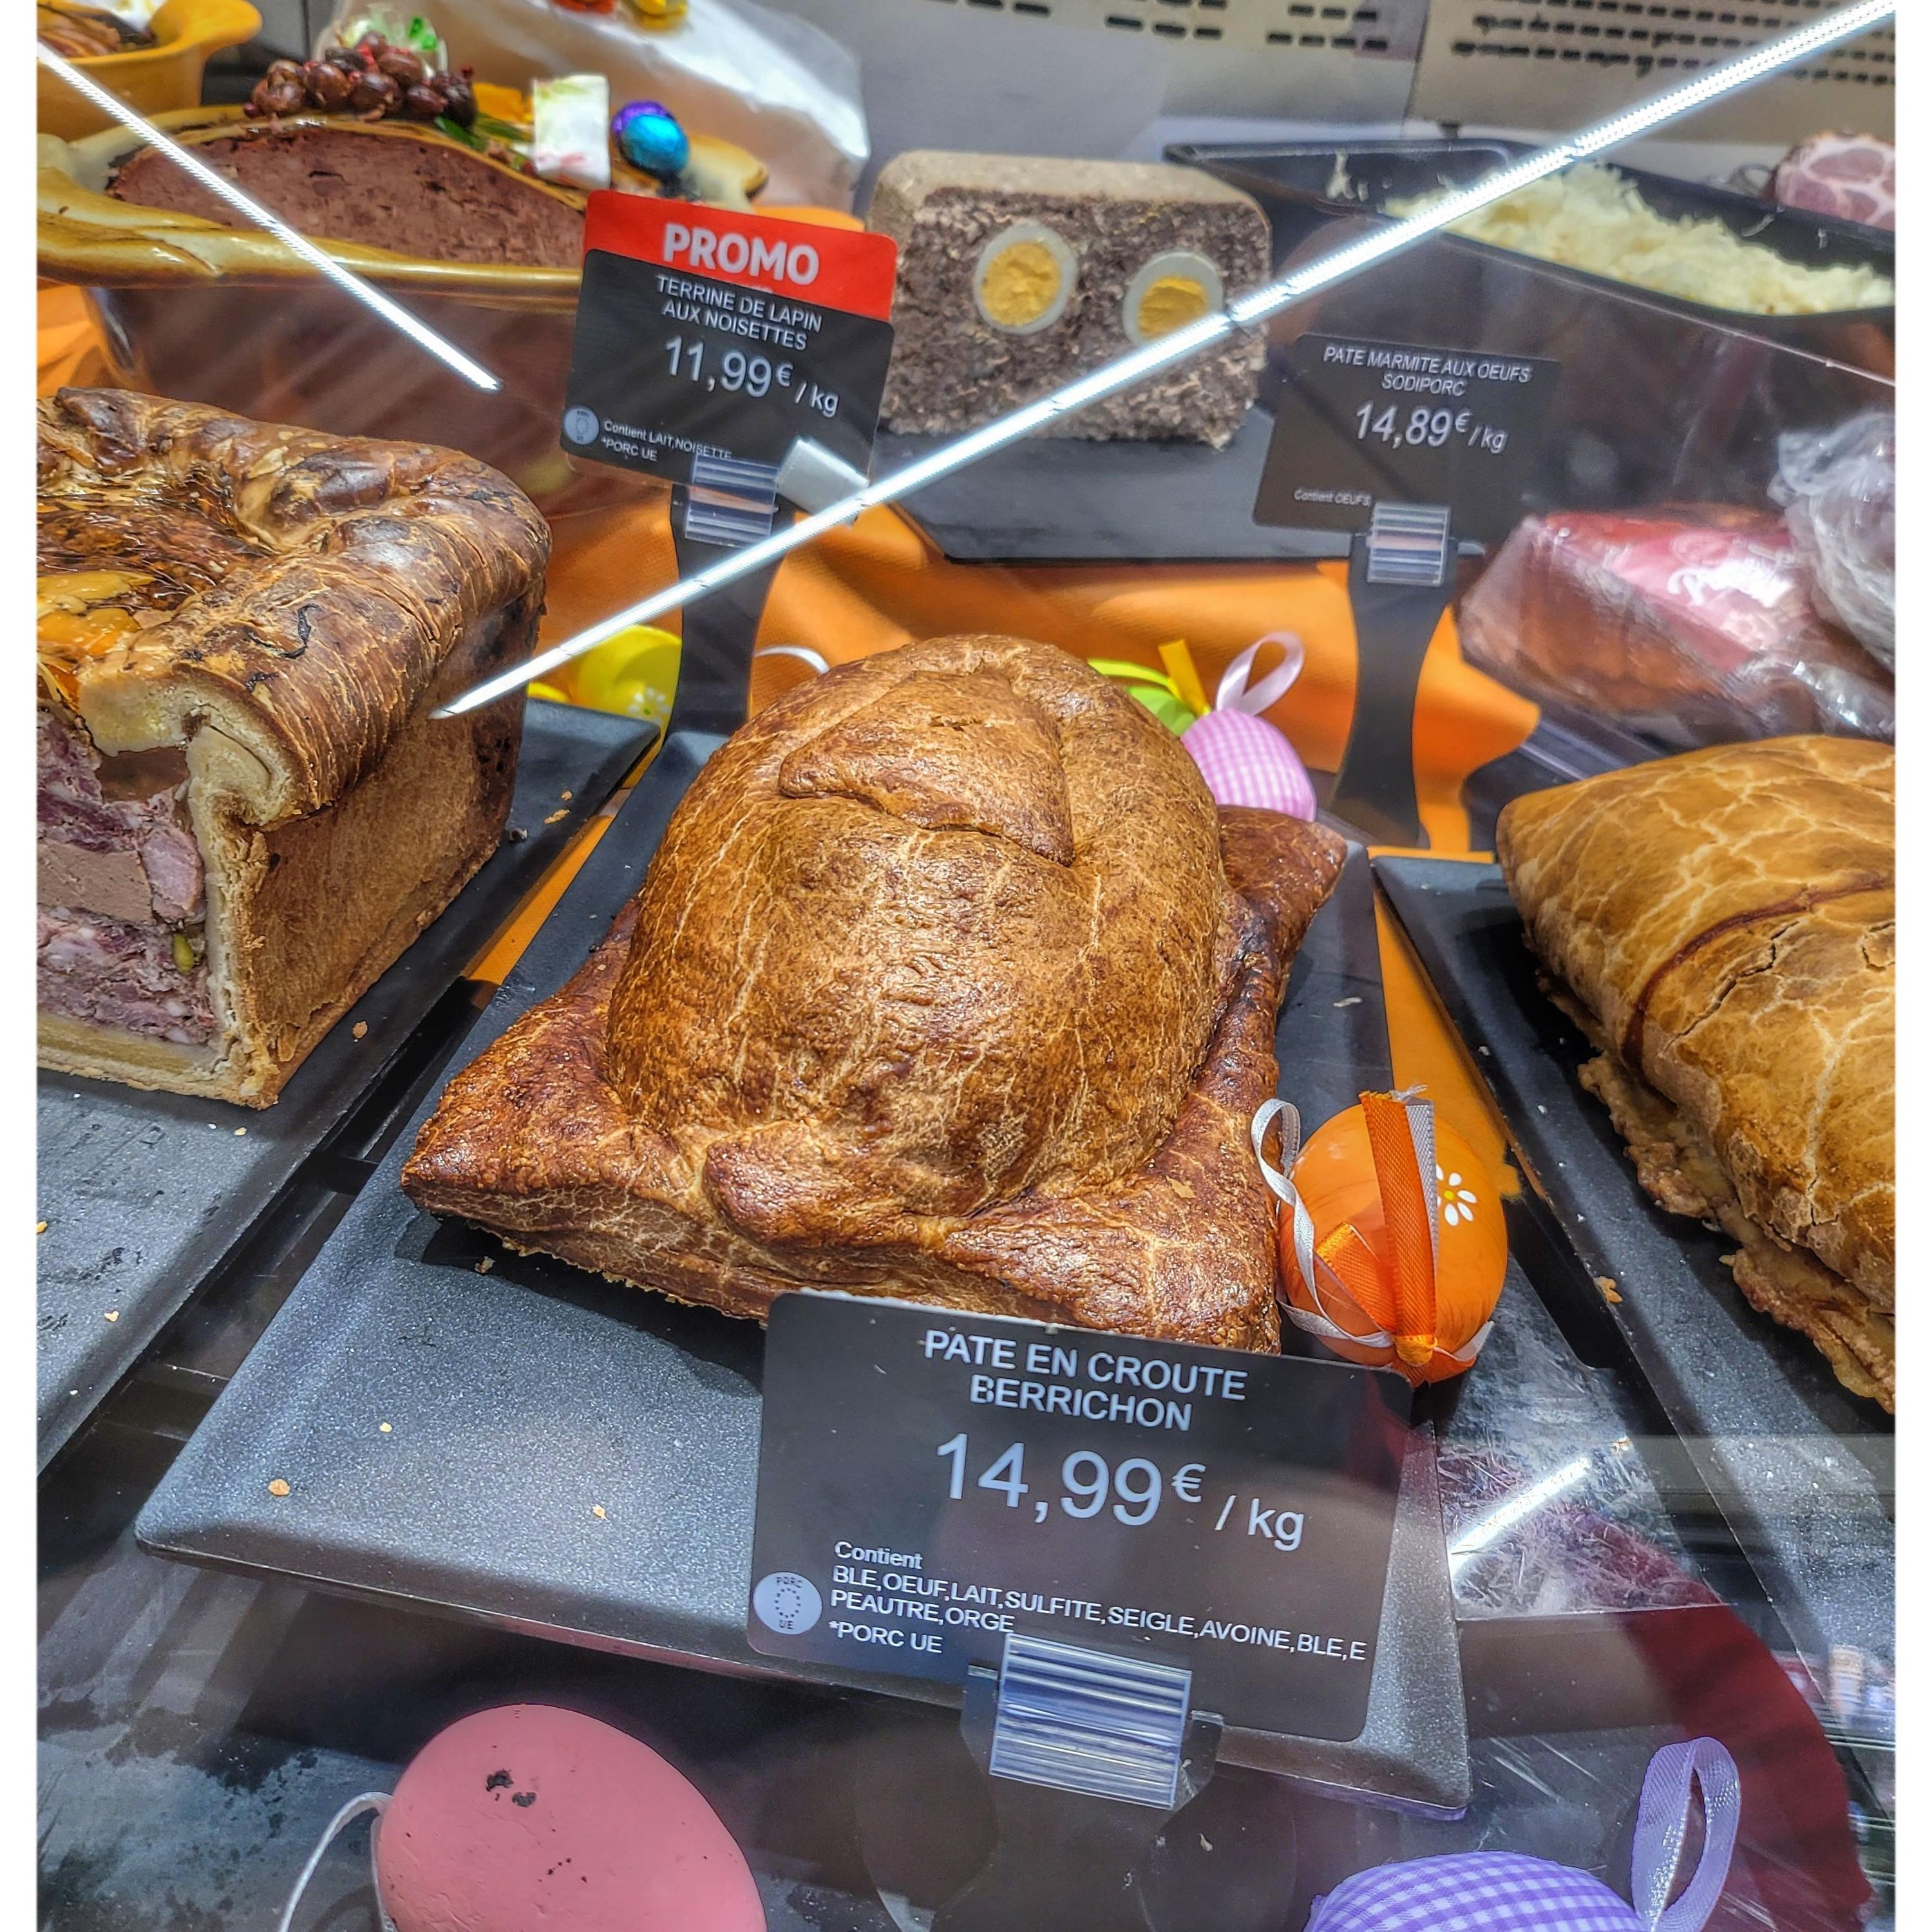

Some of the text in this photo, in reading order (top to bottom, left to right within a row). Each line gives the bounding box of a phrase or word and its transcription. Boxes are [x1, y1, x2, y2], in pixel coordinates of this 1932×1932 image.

[663, 223, 820, 285] PROMO
[656, 274, 822, 333] TERRINE DE LAPIN
[662, 299, 808, 351] AUX NOISETTES
[1323, 346, 1533, 383] PATE MARMITE AUX OEUFS
[1381, 373, 1466, 397] SODIPORC
[604, 420, 646, 441] Contient
[642, 447, 658, 462] UE
[1334, 493, 1372, 507] OEUFS
[923, 1329, 1248, 1401] PATE EN CROUTE
[970, 1374, 1193, 1432] BERRICHON
[834, 1540, 923, 1569] Contient
[910, 1632, 943, 1653] UE
